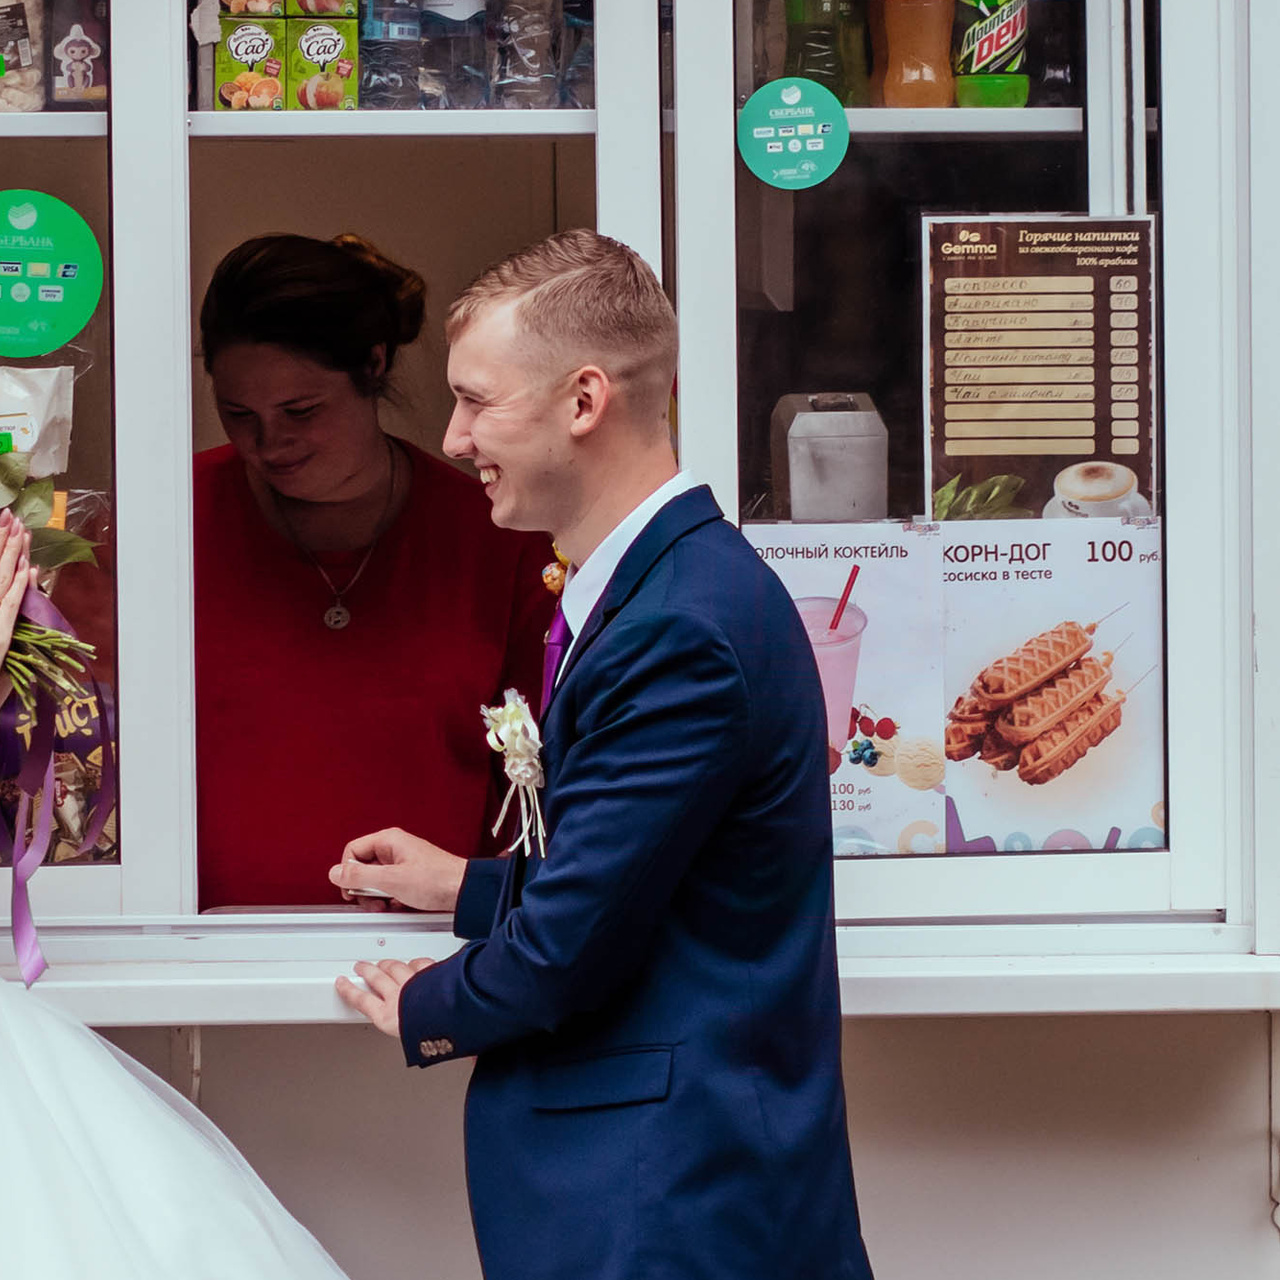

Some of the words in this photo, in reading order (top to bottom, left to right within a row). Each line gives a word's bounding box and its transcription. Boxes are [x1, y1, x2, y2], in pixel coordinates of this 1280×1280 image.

[234, 37, 266, 57] Сад
[306, 37, 338, 57] Сад
[1018, 230, 1073, 245] Горячие
[1075, 231, 1140, 243] напитки
[940, 242, 998, 255] Gemma
[1098, 257, 1139, 268] арабика
[833, 540, 909, 560] КОКТЕЙЛЬ
[942, 543, 1052, 566] КОРН-ДОГ
[1086, 540, 1134, 563] 100
[1138, 549, 1161, 565] руб.
[1002, 571, 1011, 580] в
[1014, 568, 1053, 580] тесте
[831, 783, 855, 795] 100
[831, 800, 855, 811] 130
